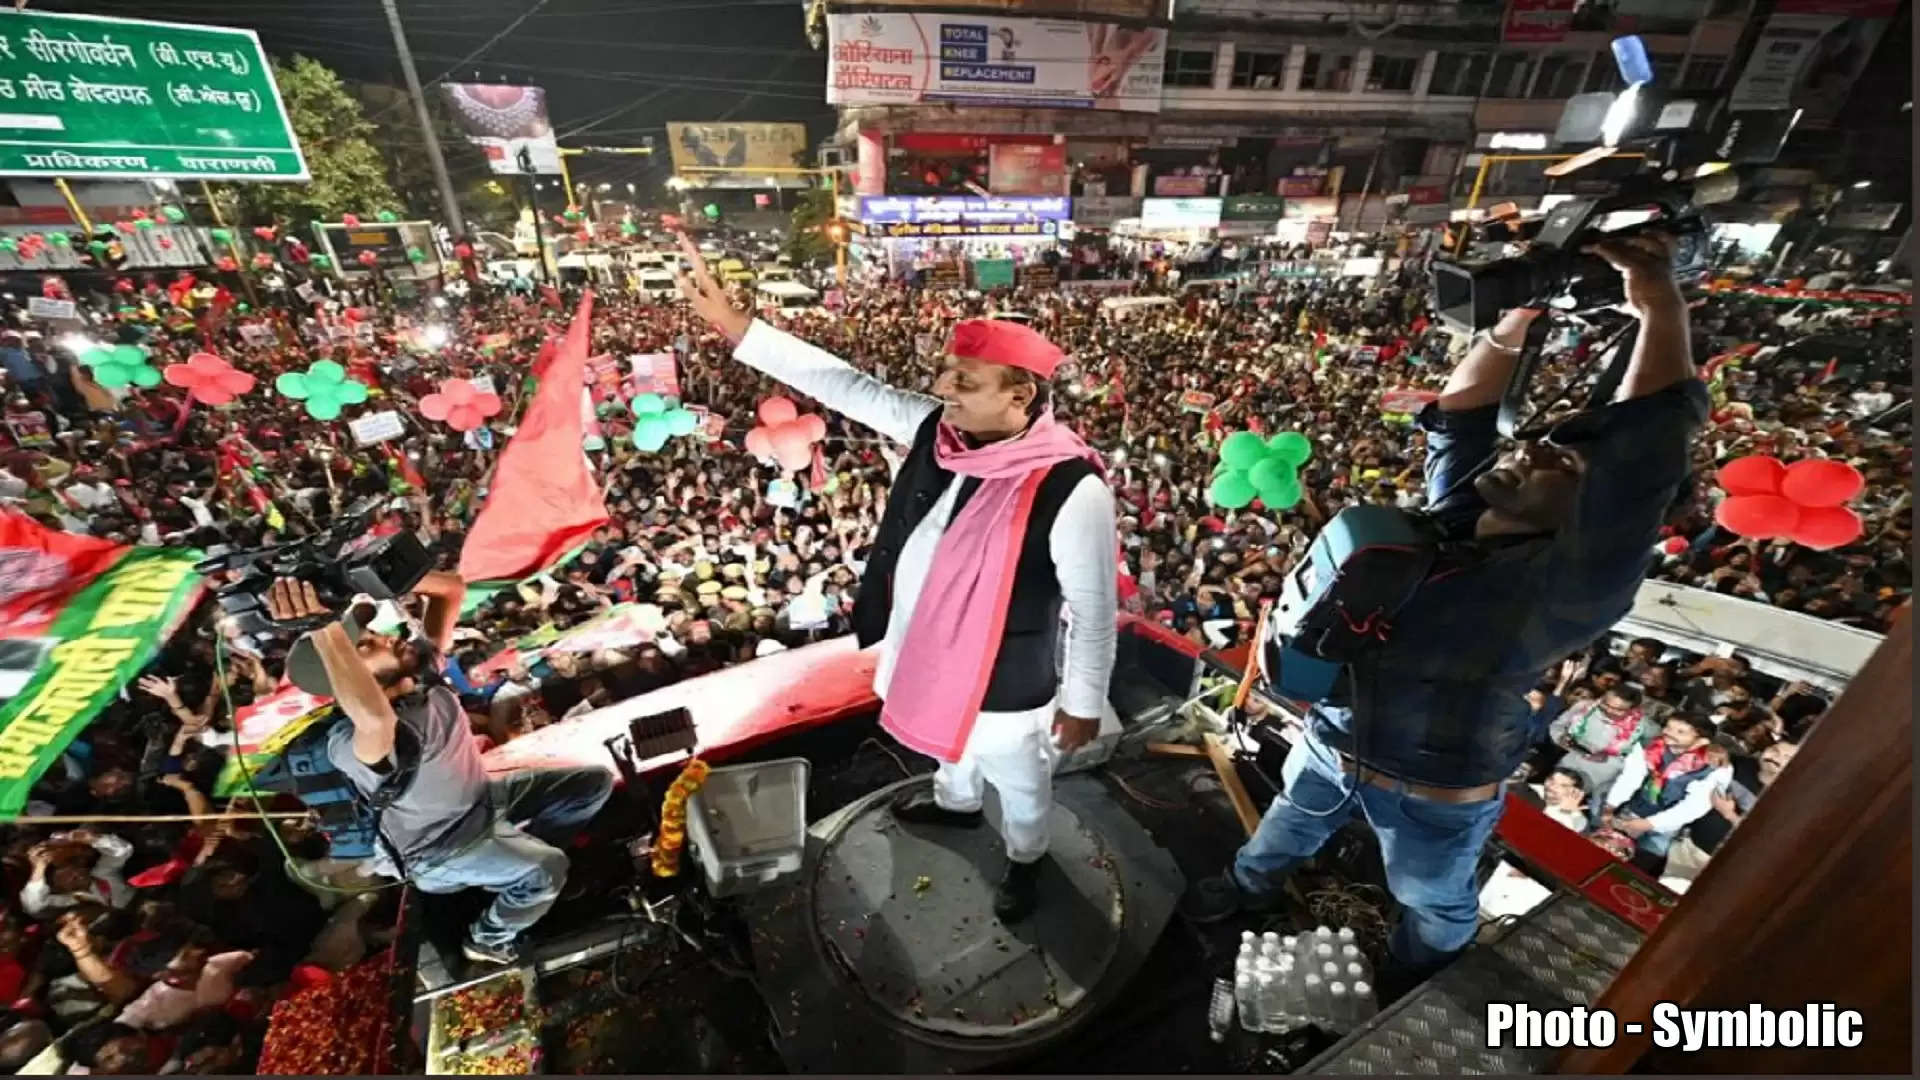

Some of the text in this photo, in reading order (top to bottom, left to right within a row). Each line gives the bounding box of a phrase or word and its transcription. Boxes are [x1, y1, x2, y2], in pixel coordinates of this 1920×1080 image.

[943, 27, 986, 42] TOTAL
[943, 45, 979, 60] KNEE
[942, 66, 1034, 82] REPLACEMENT
[177, 155, 277, 172] वाराणसी
